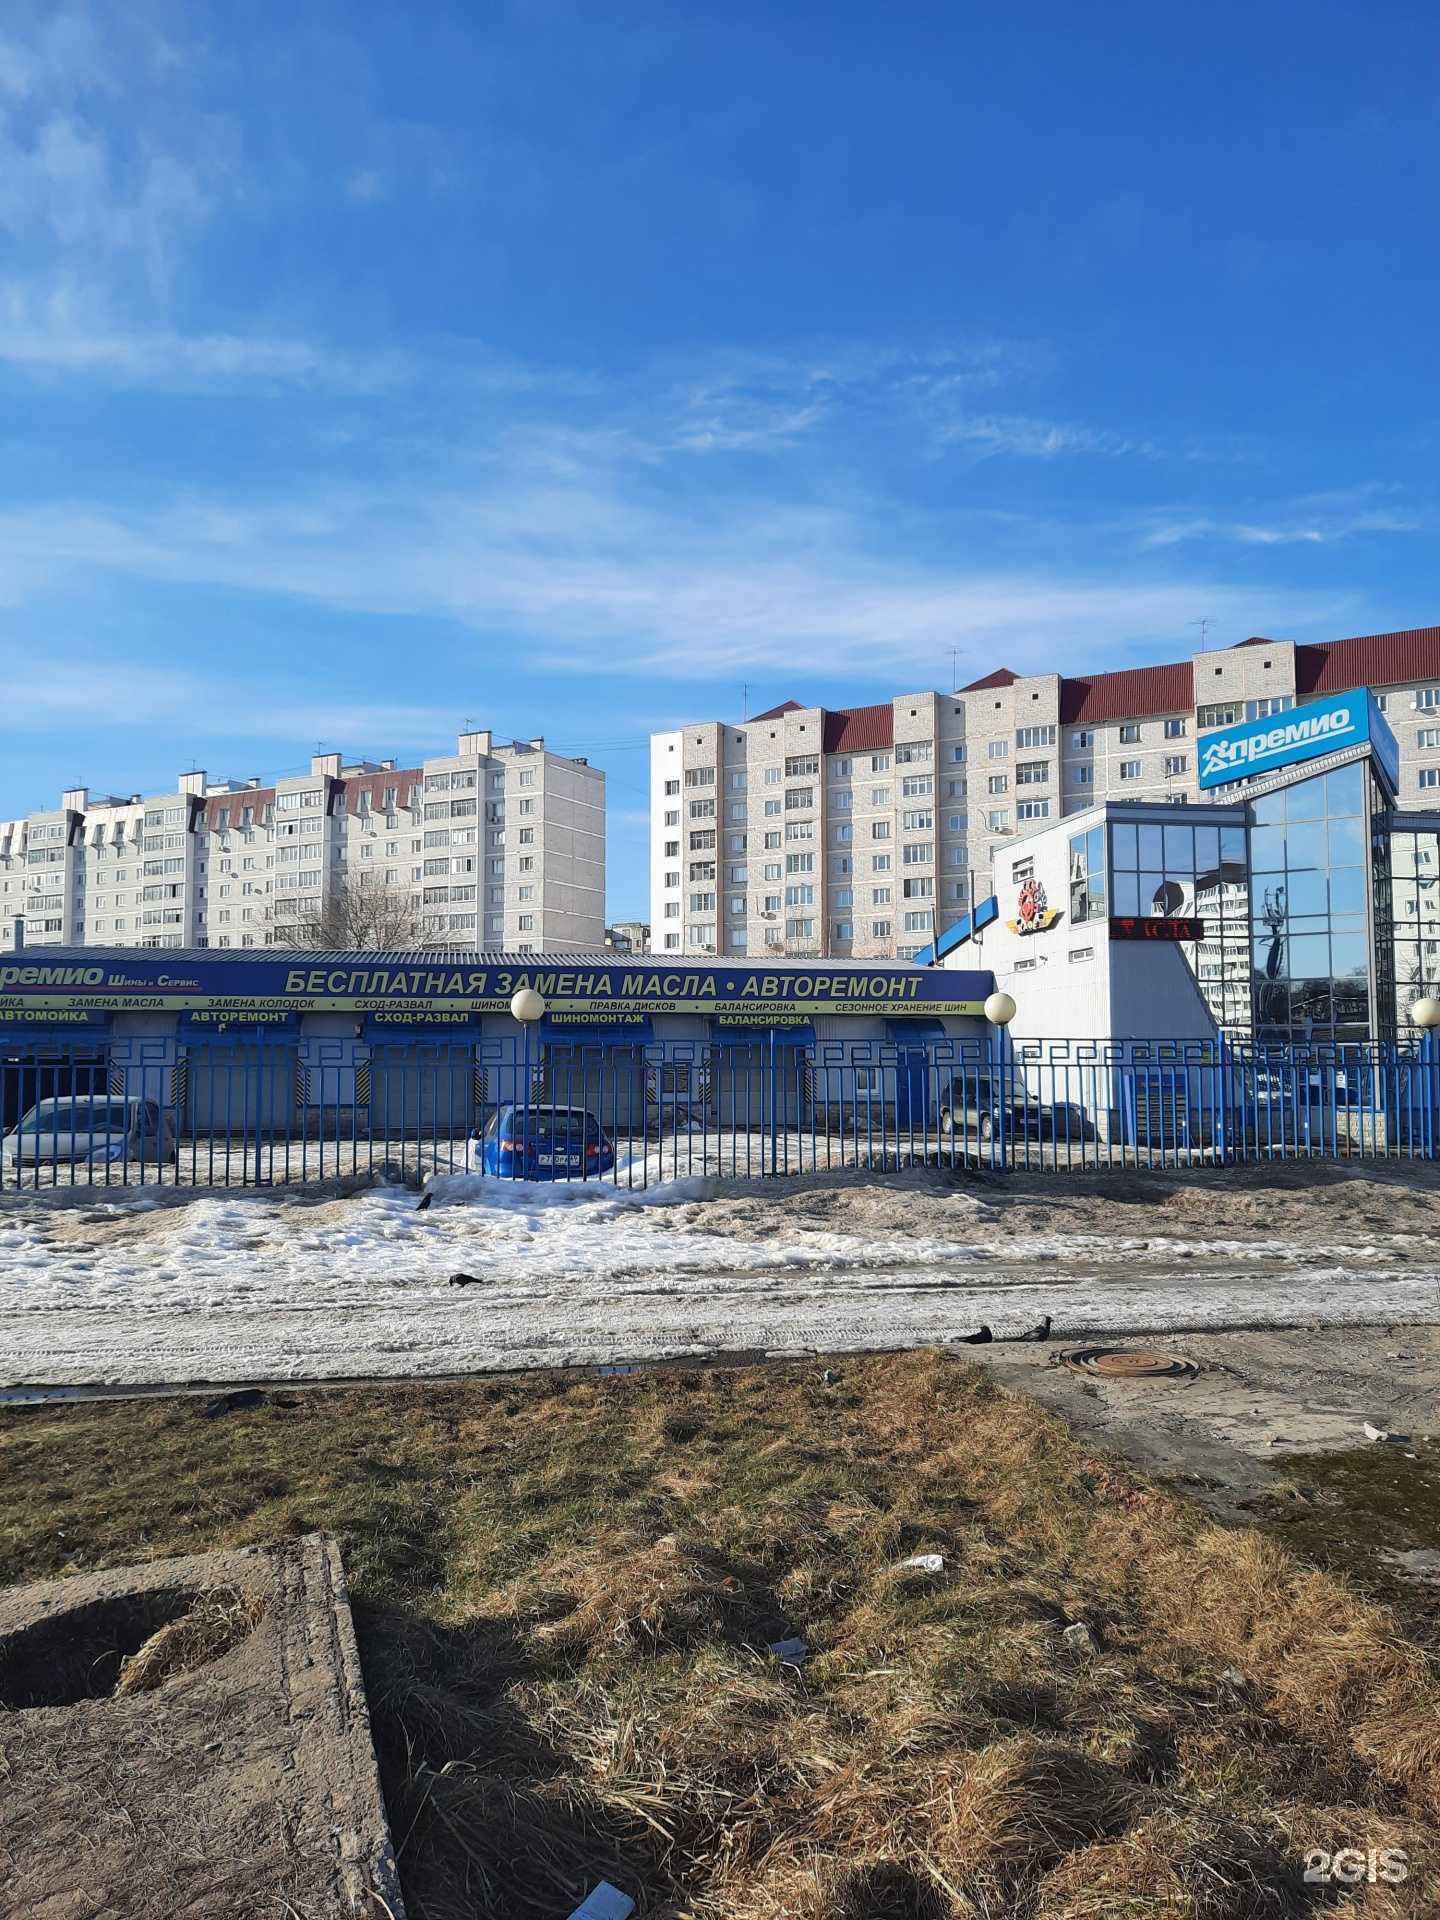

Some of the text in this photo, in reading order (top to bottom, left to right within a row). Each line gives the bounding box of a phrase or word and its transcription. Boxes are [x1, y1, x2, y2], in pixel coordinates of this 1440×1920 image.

[1228, 708, 1350, 762] премио
[284, 970, 923, 998] БЕСПЛАТНАЯ ЗАМЕНА МАСЛА АВТОРЕМОНТ
[67, 998, 120, 1008] ЗАМЕНА
[121, 998, 164, 1008] МАСЛА
[207, 998, 257, 1008] ЗАМЕНА
[258, 999, 315, 1010] КОЛОДОК
[354, 1000, 433, 1011] СХОД-РАЗВАЛ
[470, 1000, 552, 1010] ШИНОМЖ
[589, 1001, 631, 1011] ПРАВКА
[632, 1001, 676, 1012] ДИСКОВ
[714, 1002, 796, 1012] БАЛАНСИРОВКА
[835, 1003, 888, 1012] СЕЗОННОЕ
[890, 1003, 942, 1012] ХРАНЕНИЕ
[944, 1003, 967, 1012] ШИН
[190, 1012, 289, 1022] АВТОРЕМОНТ
[374, 1013, 469, 1023] СХОД-РАЗВАЛ
[551, 1014, 644, 1023] ШИНОМОНТАЖ
[719, 1015, 811, 1025] БАЛАНСИРОВКА
